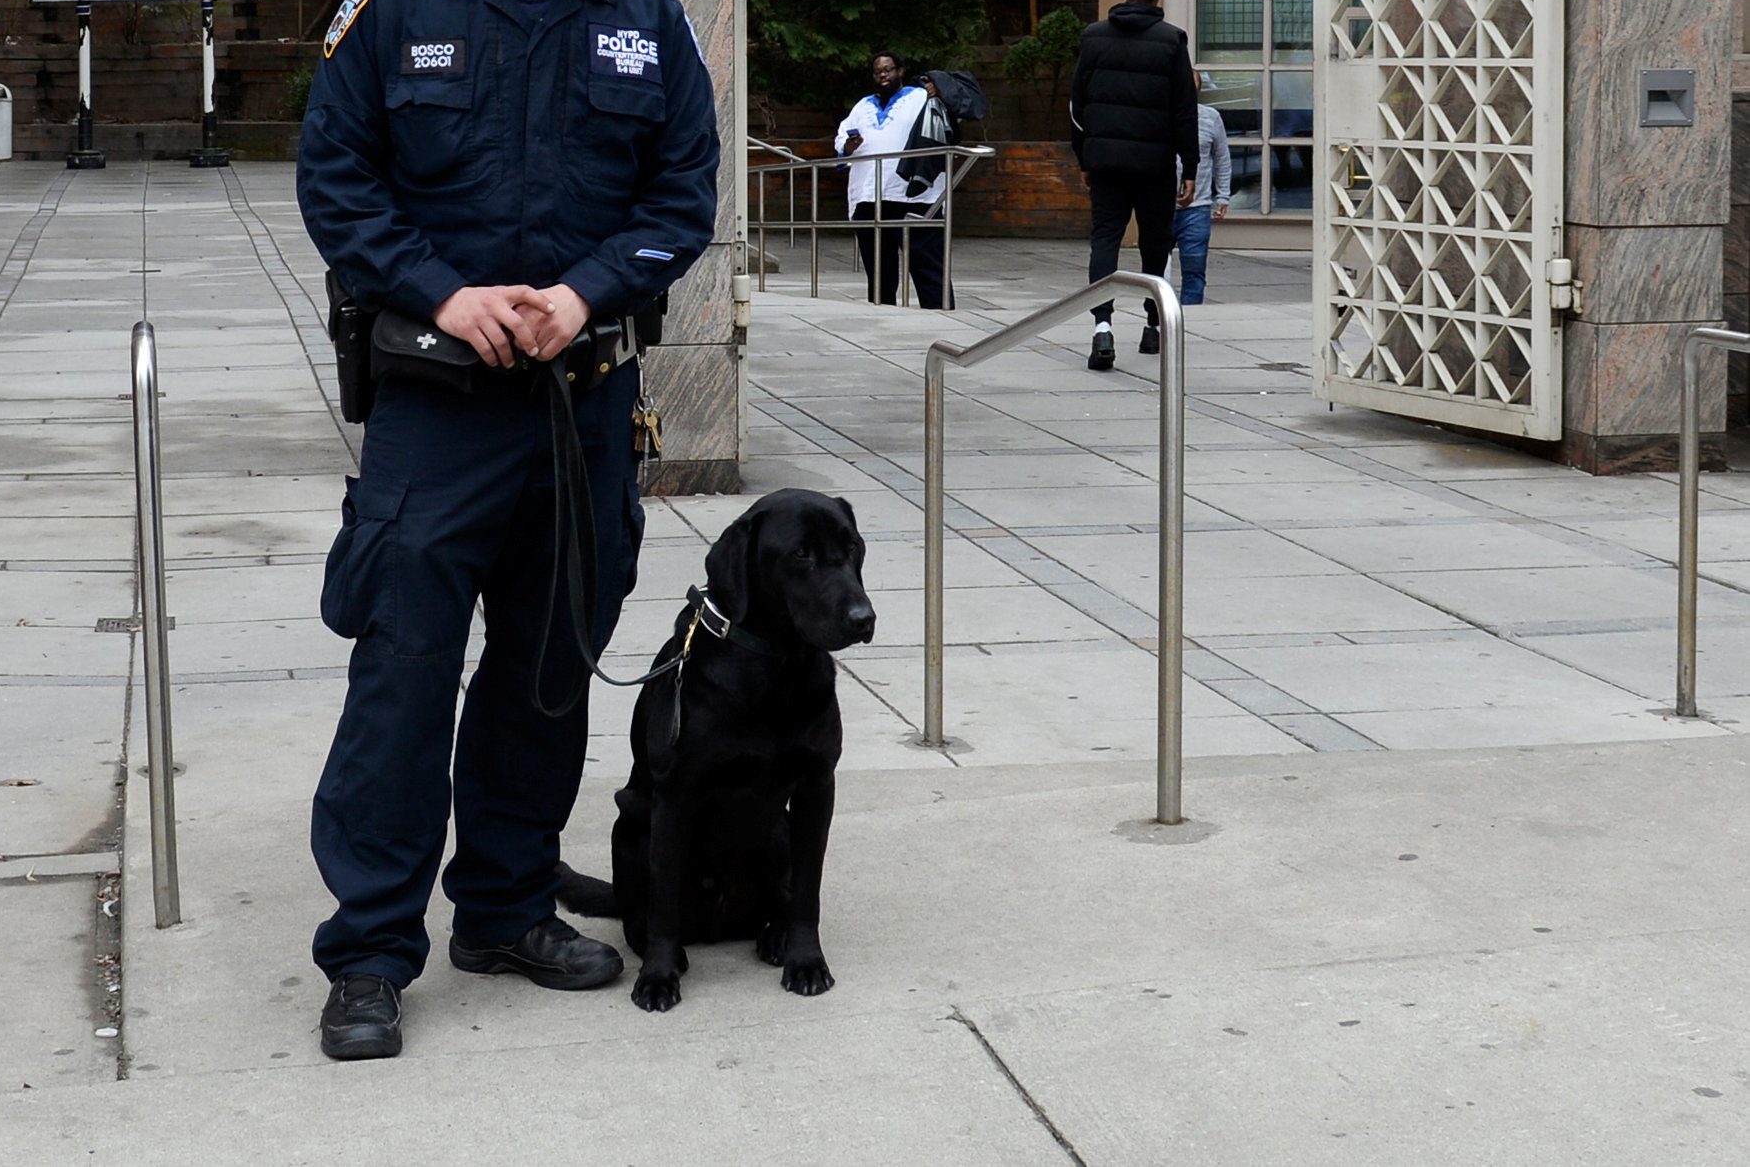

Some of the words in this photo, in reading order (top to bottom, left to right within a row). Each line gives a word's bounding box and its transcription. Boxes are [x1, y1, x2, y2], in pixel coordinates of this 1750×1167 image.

[411, 43, 455, 57] BOSCO
[597, 33, 658, 57] POLICE
[413, 56, 452, 69] 20601
